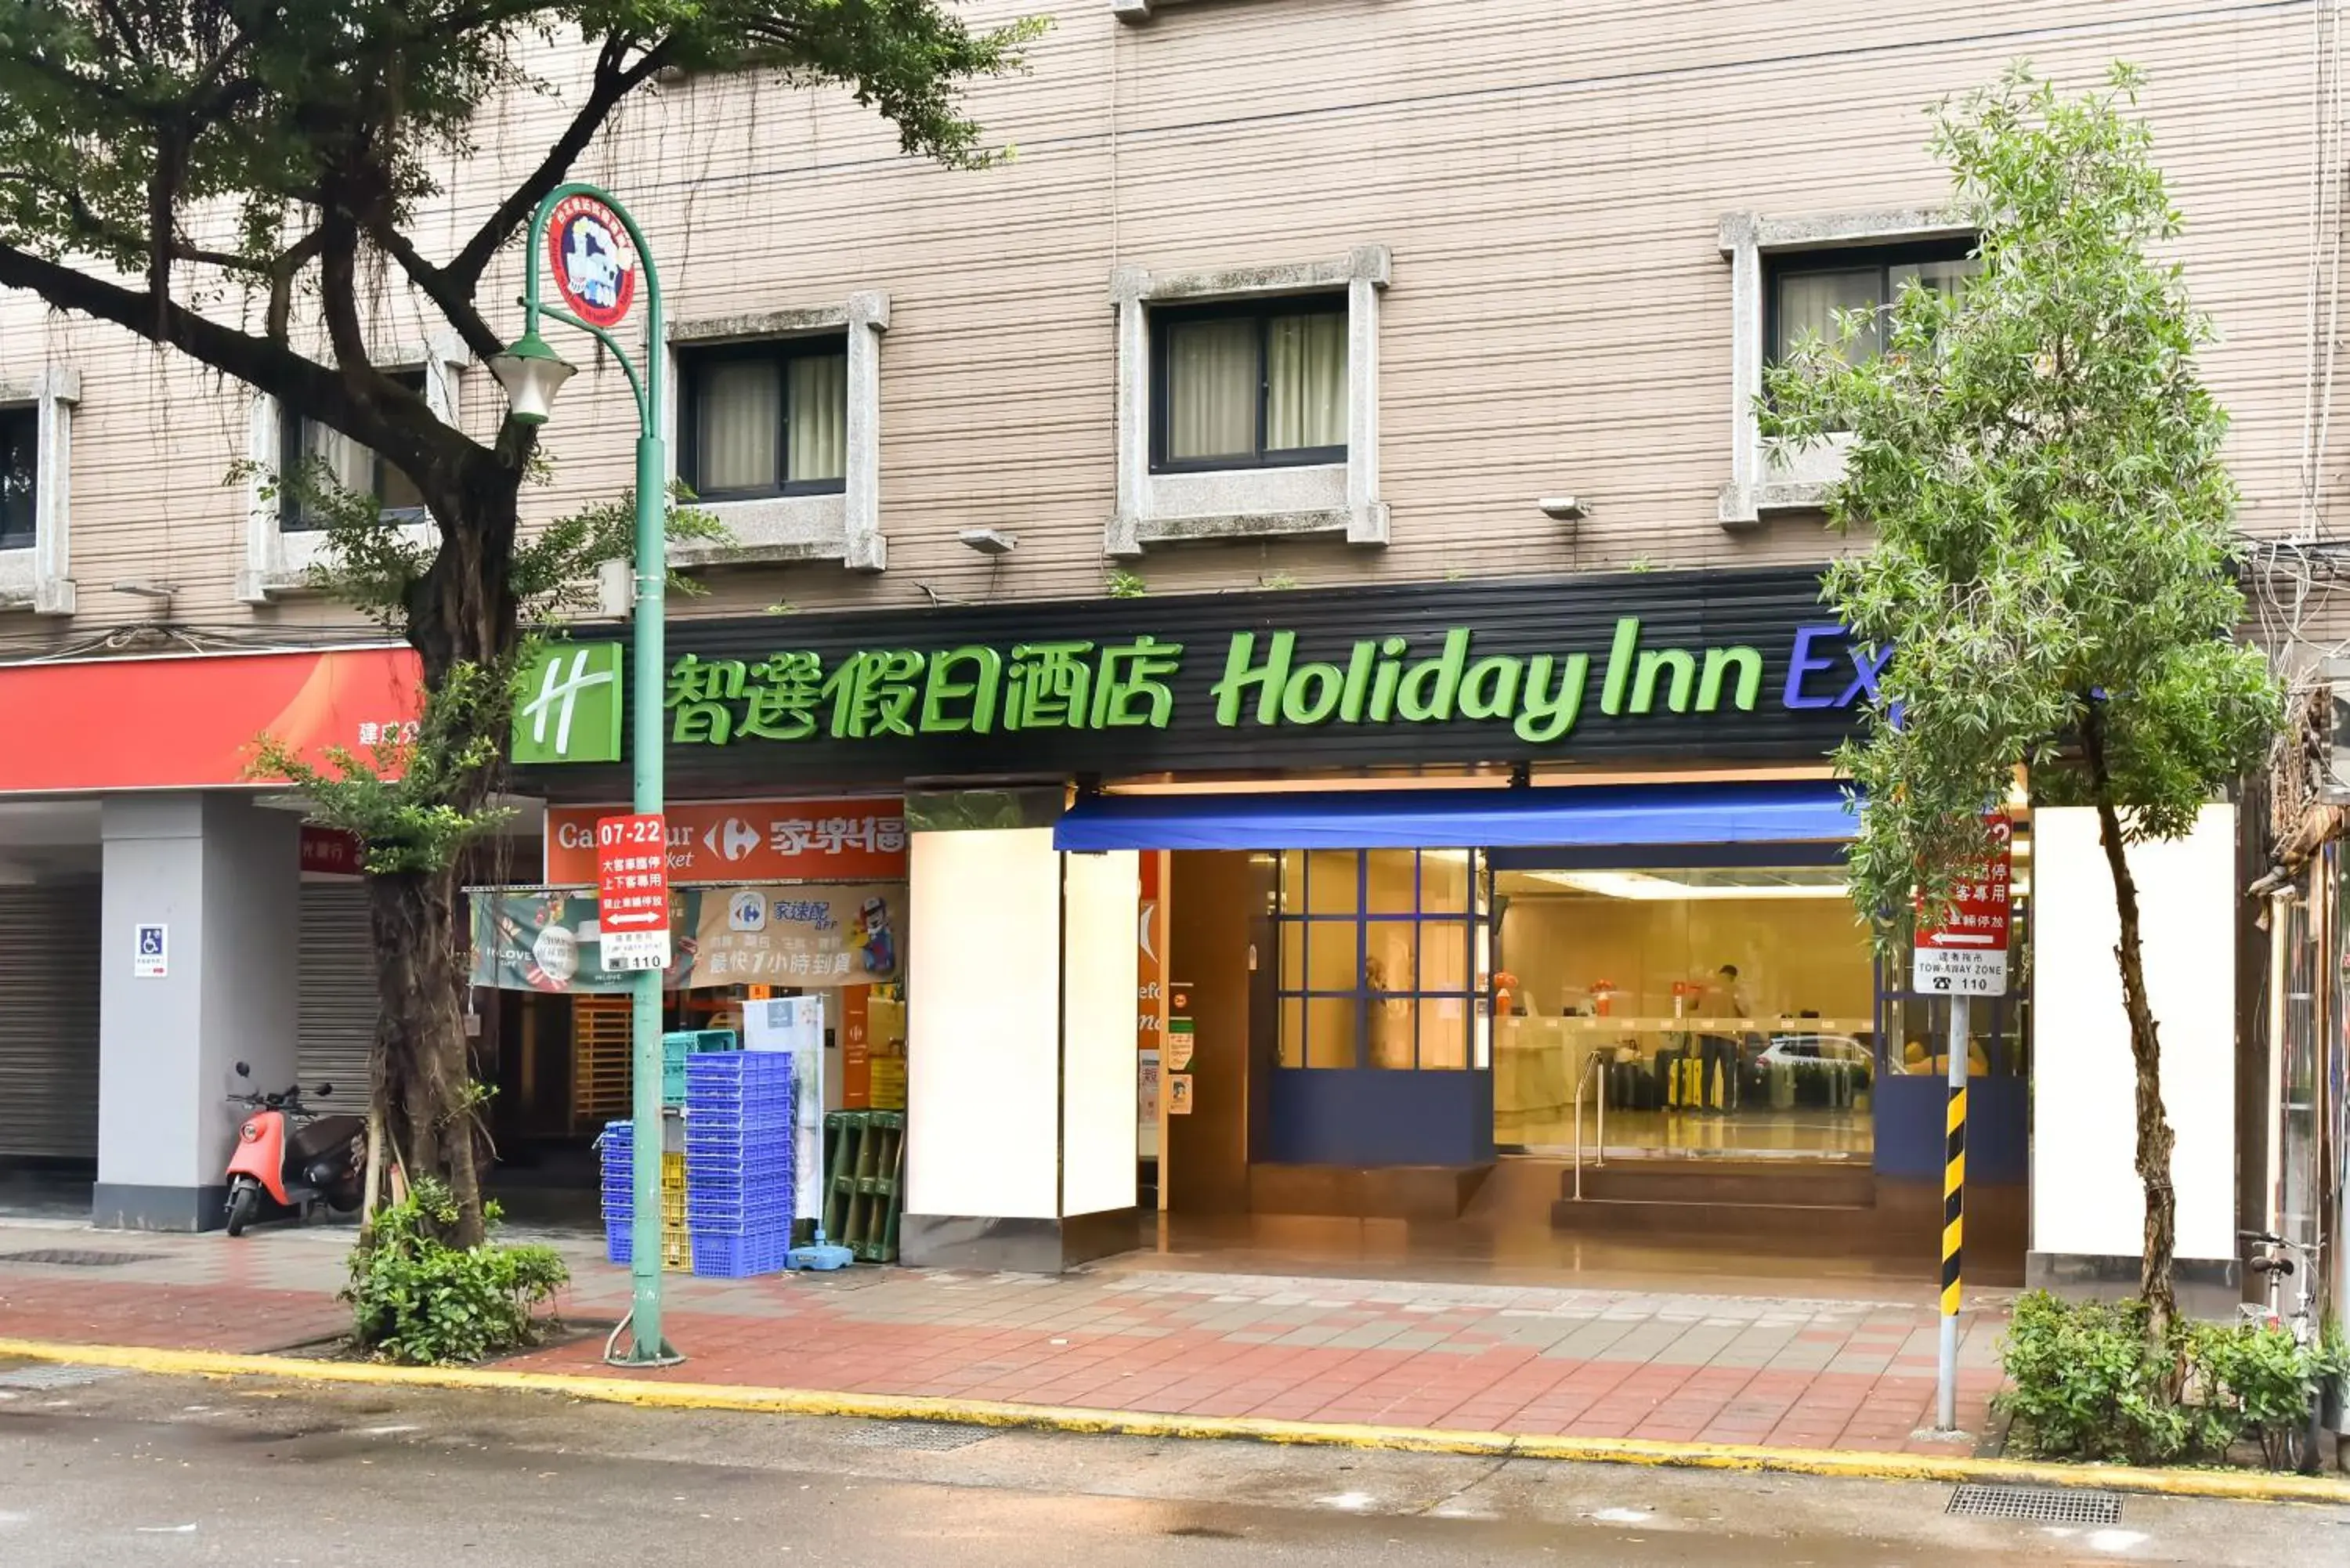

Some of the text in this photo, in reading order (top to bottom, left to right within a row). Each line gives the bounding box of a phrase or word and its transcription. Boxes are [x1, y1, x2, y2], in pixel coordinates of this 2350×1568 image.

[664, 635, 1184, 746] 智選假日酒店
[1210, 627, 1590, 742] Holiday
[1600, 615, 1762, 716] Inn
[601, 820, 661, 845] 07-22
[770, 816, 906, 856] 家樂福
[632, 955, 661, 969] 110
[1975, 965, 2002, 975] ZONE
[1961, 977, 1987, 991] 110
